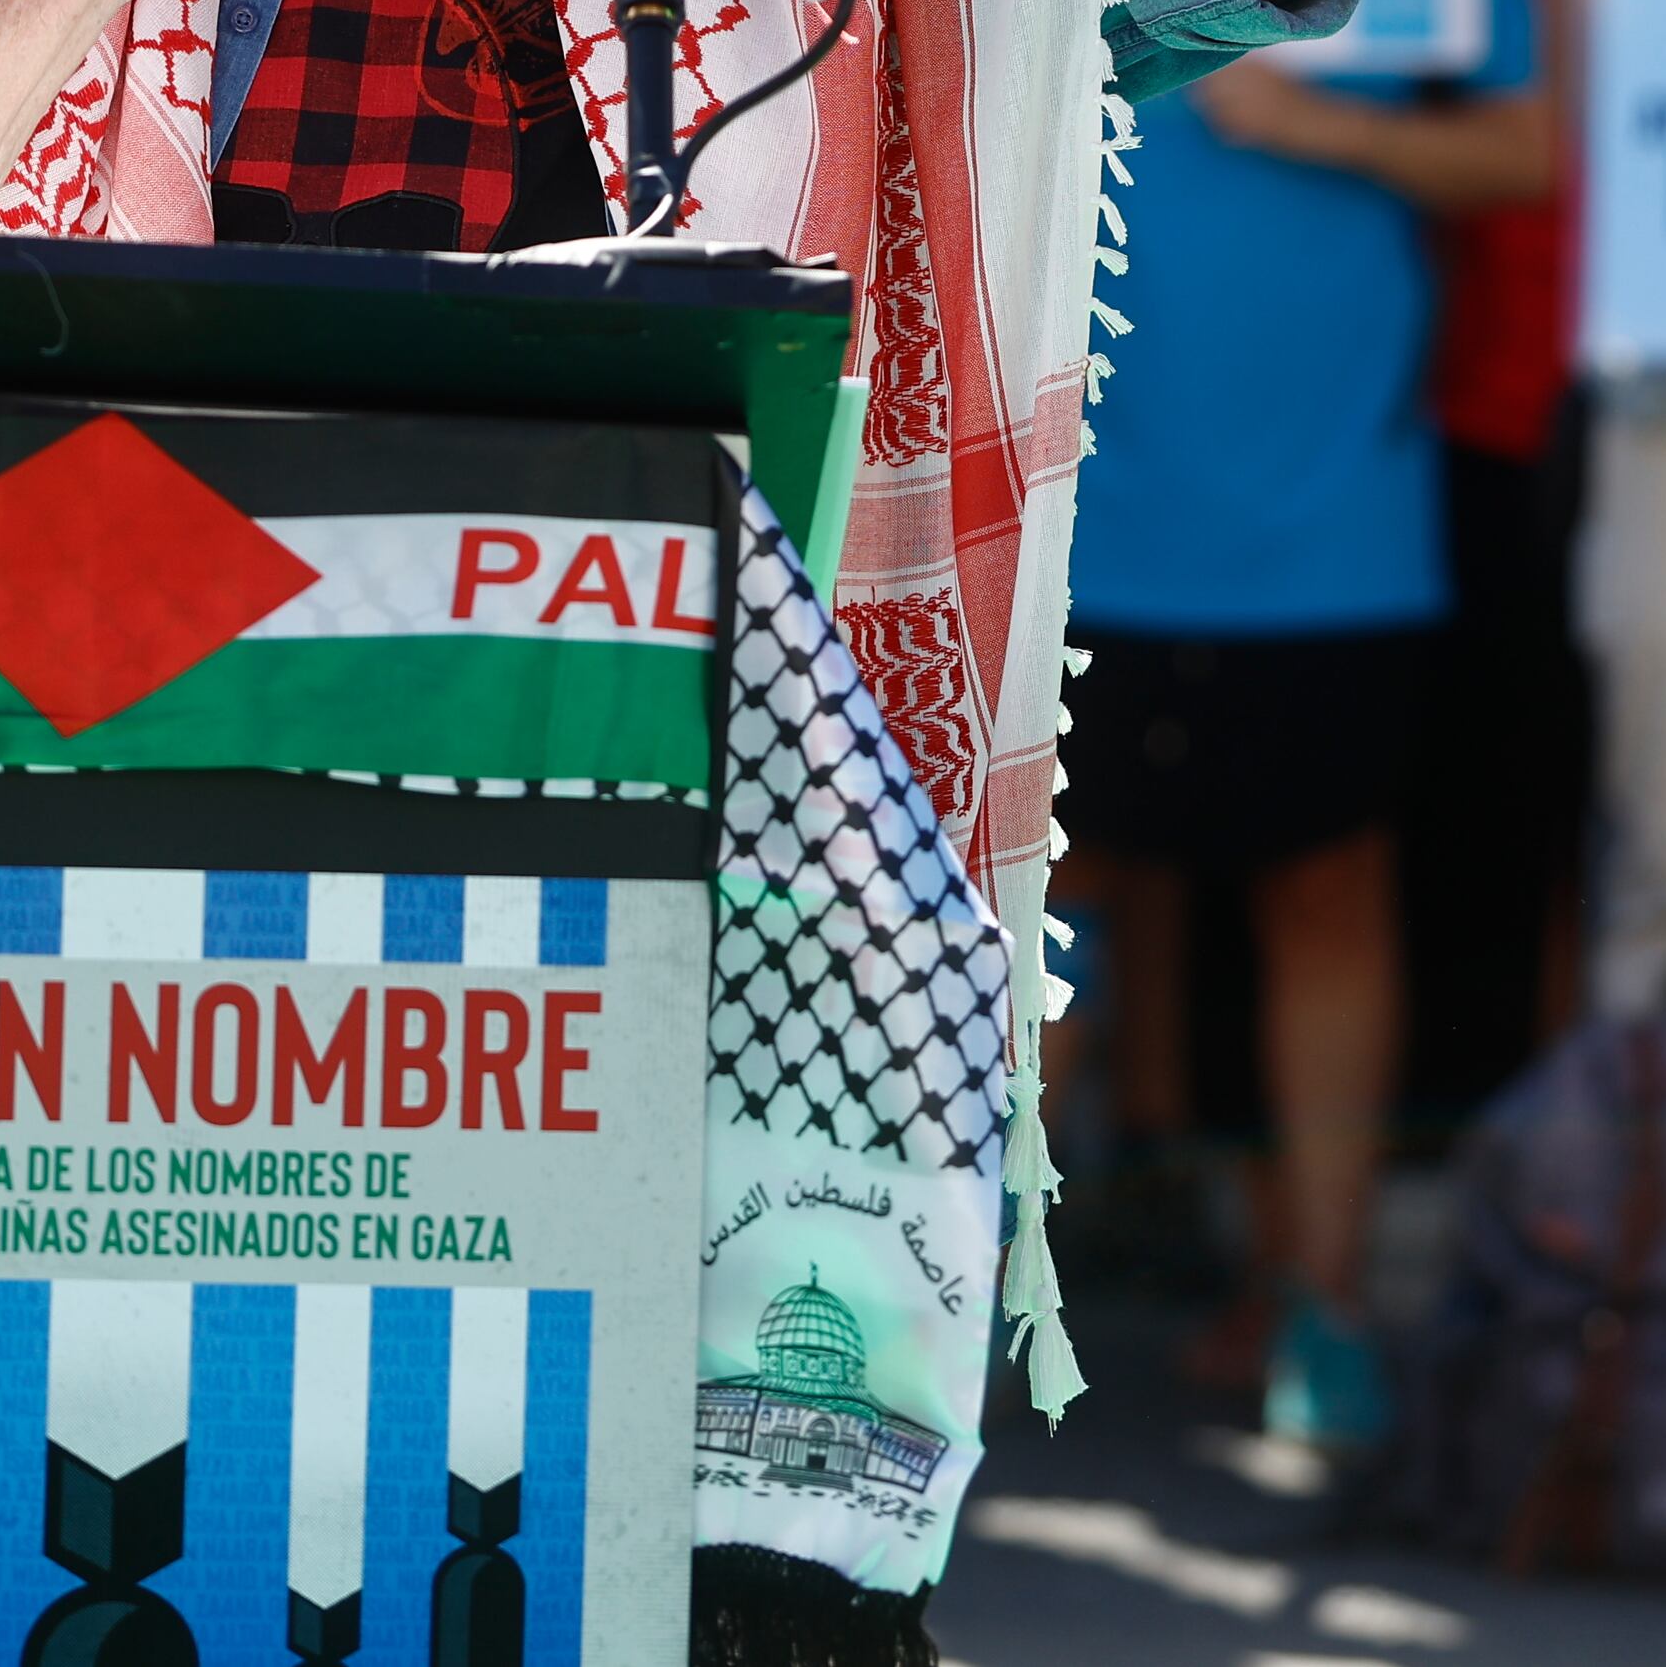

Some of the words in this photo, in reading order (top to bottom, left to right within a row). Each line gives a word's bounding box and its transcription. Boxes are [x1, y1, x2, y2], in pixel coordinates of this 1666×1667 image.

[451, 528, 716, 636] PAL
[108, 982, 602, 1132] NOMBRE
[26, 1145, 73, 1193] DE
[86, 1147, 156, 1195] LOS
[167, 1148, 353, 1199] NOMBRES
[364, 1152, 411, 1200] DE
[785, 1171, 893, 1219] فلسطين
[98, 1207, 339, 1261] ASESINADOS
[351, 1213, 399, 1261] EN
[410, 1214, 514, 1264] GAZA
[699, 1180, 773, 1268] القدس
[900, 1212, 966, 1318] عاصمة
